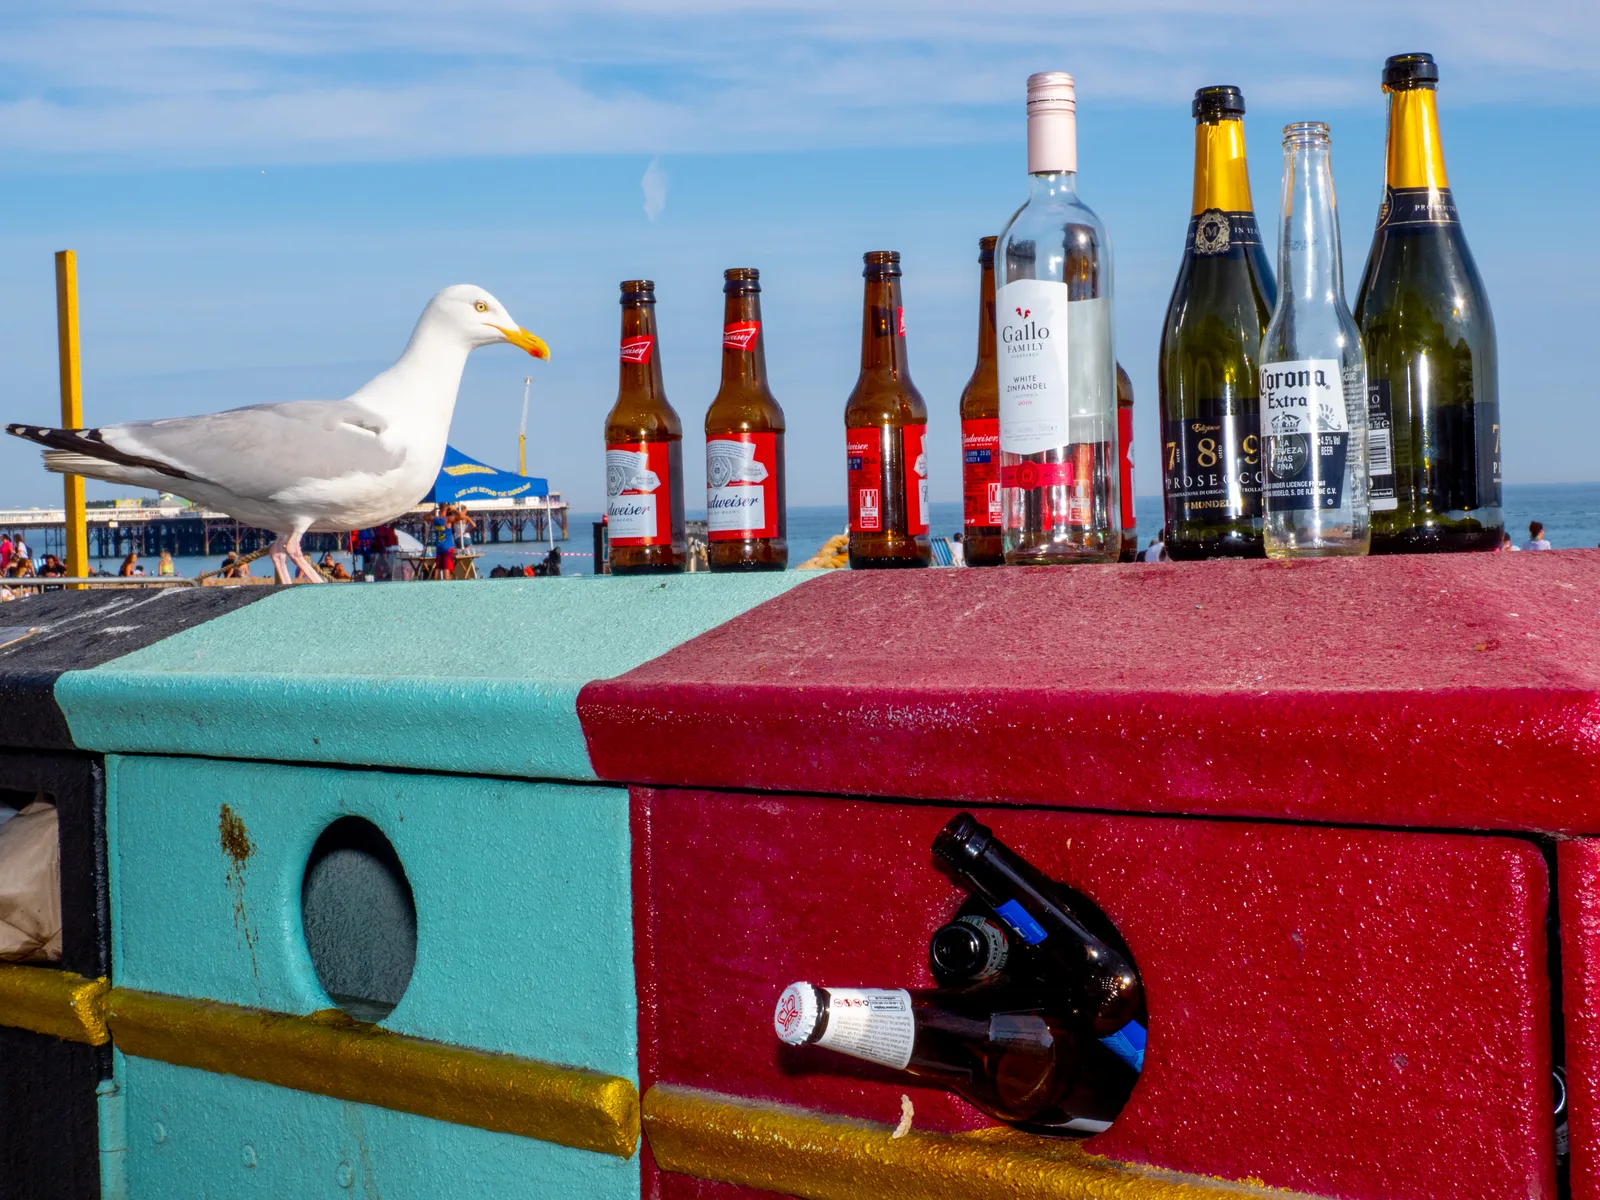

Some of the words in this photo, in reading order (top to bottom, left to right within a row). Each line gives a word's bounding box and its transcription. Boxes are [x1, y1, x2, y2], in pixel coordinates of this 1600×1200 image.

[1002, 320, 1050, 344] Gallo
[1007, 342, 1044, 354] FAMILY
[1007, 382, 1048, 393] ZINFANDEL
[1013, 375, 1037, 383] WHITE
[1260, 367, 1327, 398] Corona
[1268, 392, 1308, 410] Extra
[1167, 442, 1177, 471] 7
[1198, 438, 1217, 467] 8
[1243, 435, 1259, 464] 9
